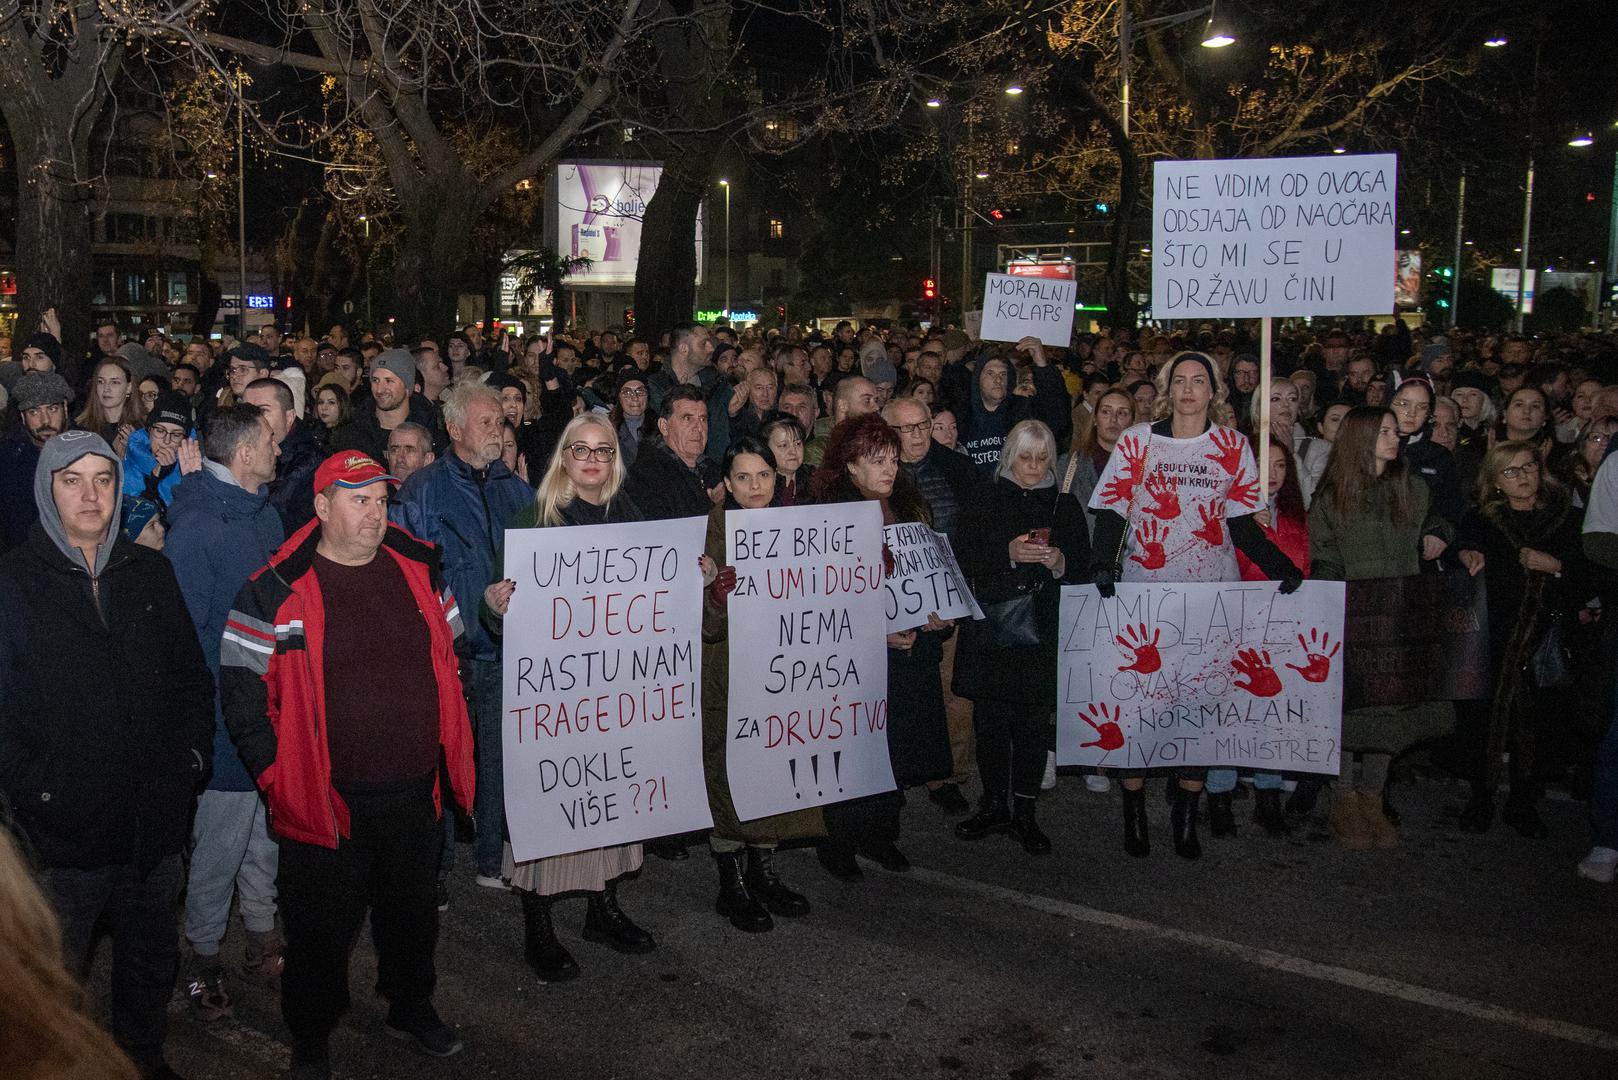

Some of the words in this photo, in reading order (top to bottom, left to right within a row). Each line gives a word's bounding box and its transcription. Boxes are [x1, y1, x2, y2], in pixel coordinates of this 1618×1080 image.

[1166, 175, 1201, 200] NE
[1215, 173, 1270, 198] VIDIM
[1280, 173, 1308, 197] OD
[1318, 169, 1387, 195] OVOGA
[1163, 208, 1251, 233] ODSJAJA
[1261, 205, 1286, 230] OD
[1296, 198, 1394, 227] NAOČARA
[1163, 239, 1208, 268] ŠTO
[1221, 242, 1247, 267] MI
[1263, 240, 1303, 265] SE
[1324, 238, 1342, 263] U
[989, 278, 1072, 303] MORALNI
[1167, 272, 1268, 309] DRŽAVU
[1284, 272, 1335, 302] ČINI
[996, 300, 1063, 323] KOLAPS
[966, 440, 979, 449] NE
[1188, 464, 1208, 474] VAM
[735, 528, 781, 561] BEZ
[794, 520, 855, 557] BRIGE
[533, 545, 679, 588] UMJESTO
[733, 575, 758, 597] ZA
[766, 567, 805, 600] UM
[825, 556, 882, 596] DUŠU
[552, 590, 676, 641] DJECE,
[779, 608, 853, 647] NEMA
[517, 648, 620, 696] RASTU
[632, 639, 693, 681] NAM
[765, 654, 860, 694] SPASA
[1065, 662, 1094, 704] LI
[1110, 669, 1229, 701] OVAKO
[509, 682, 696, 744] TRAGEDIJE!
[735, 717, 760, 740] ZA
[764, 694, 888, 749] DRUŠTVO
[1138, 698, 1304, 733] NORMALAN
[539, 746, 637, 793] DOKLE
[1215, 733, 1336, 768] MINISTRE?
[788, 750, 843, 800] !!!
